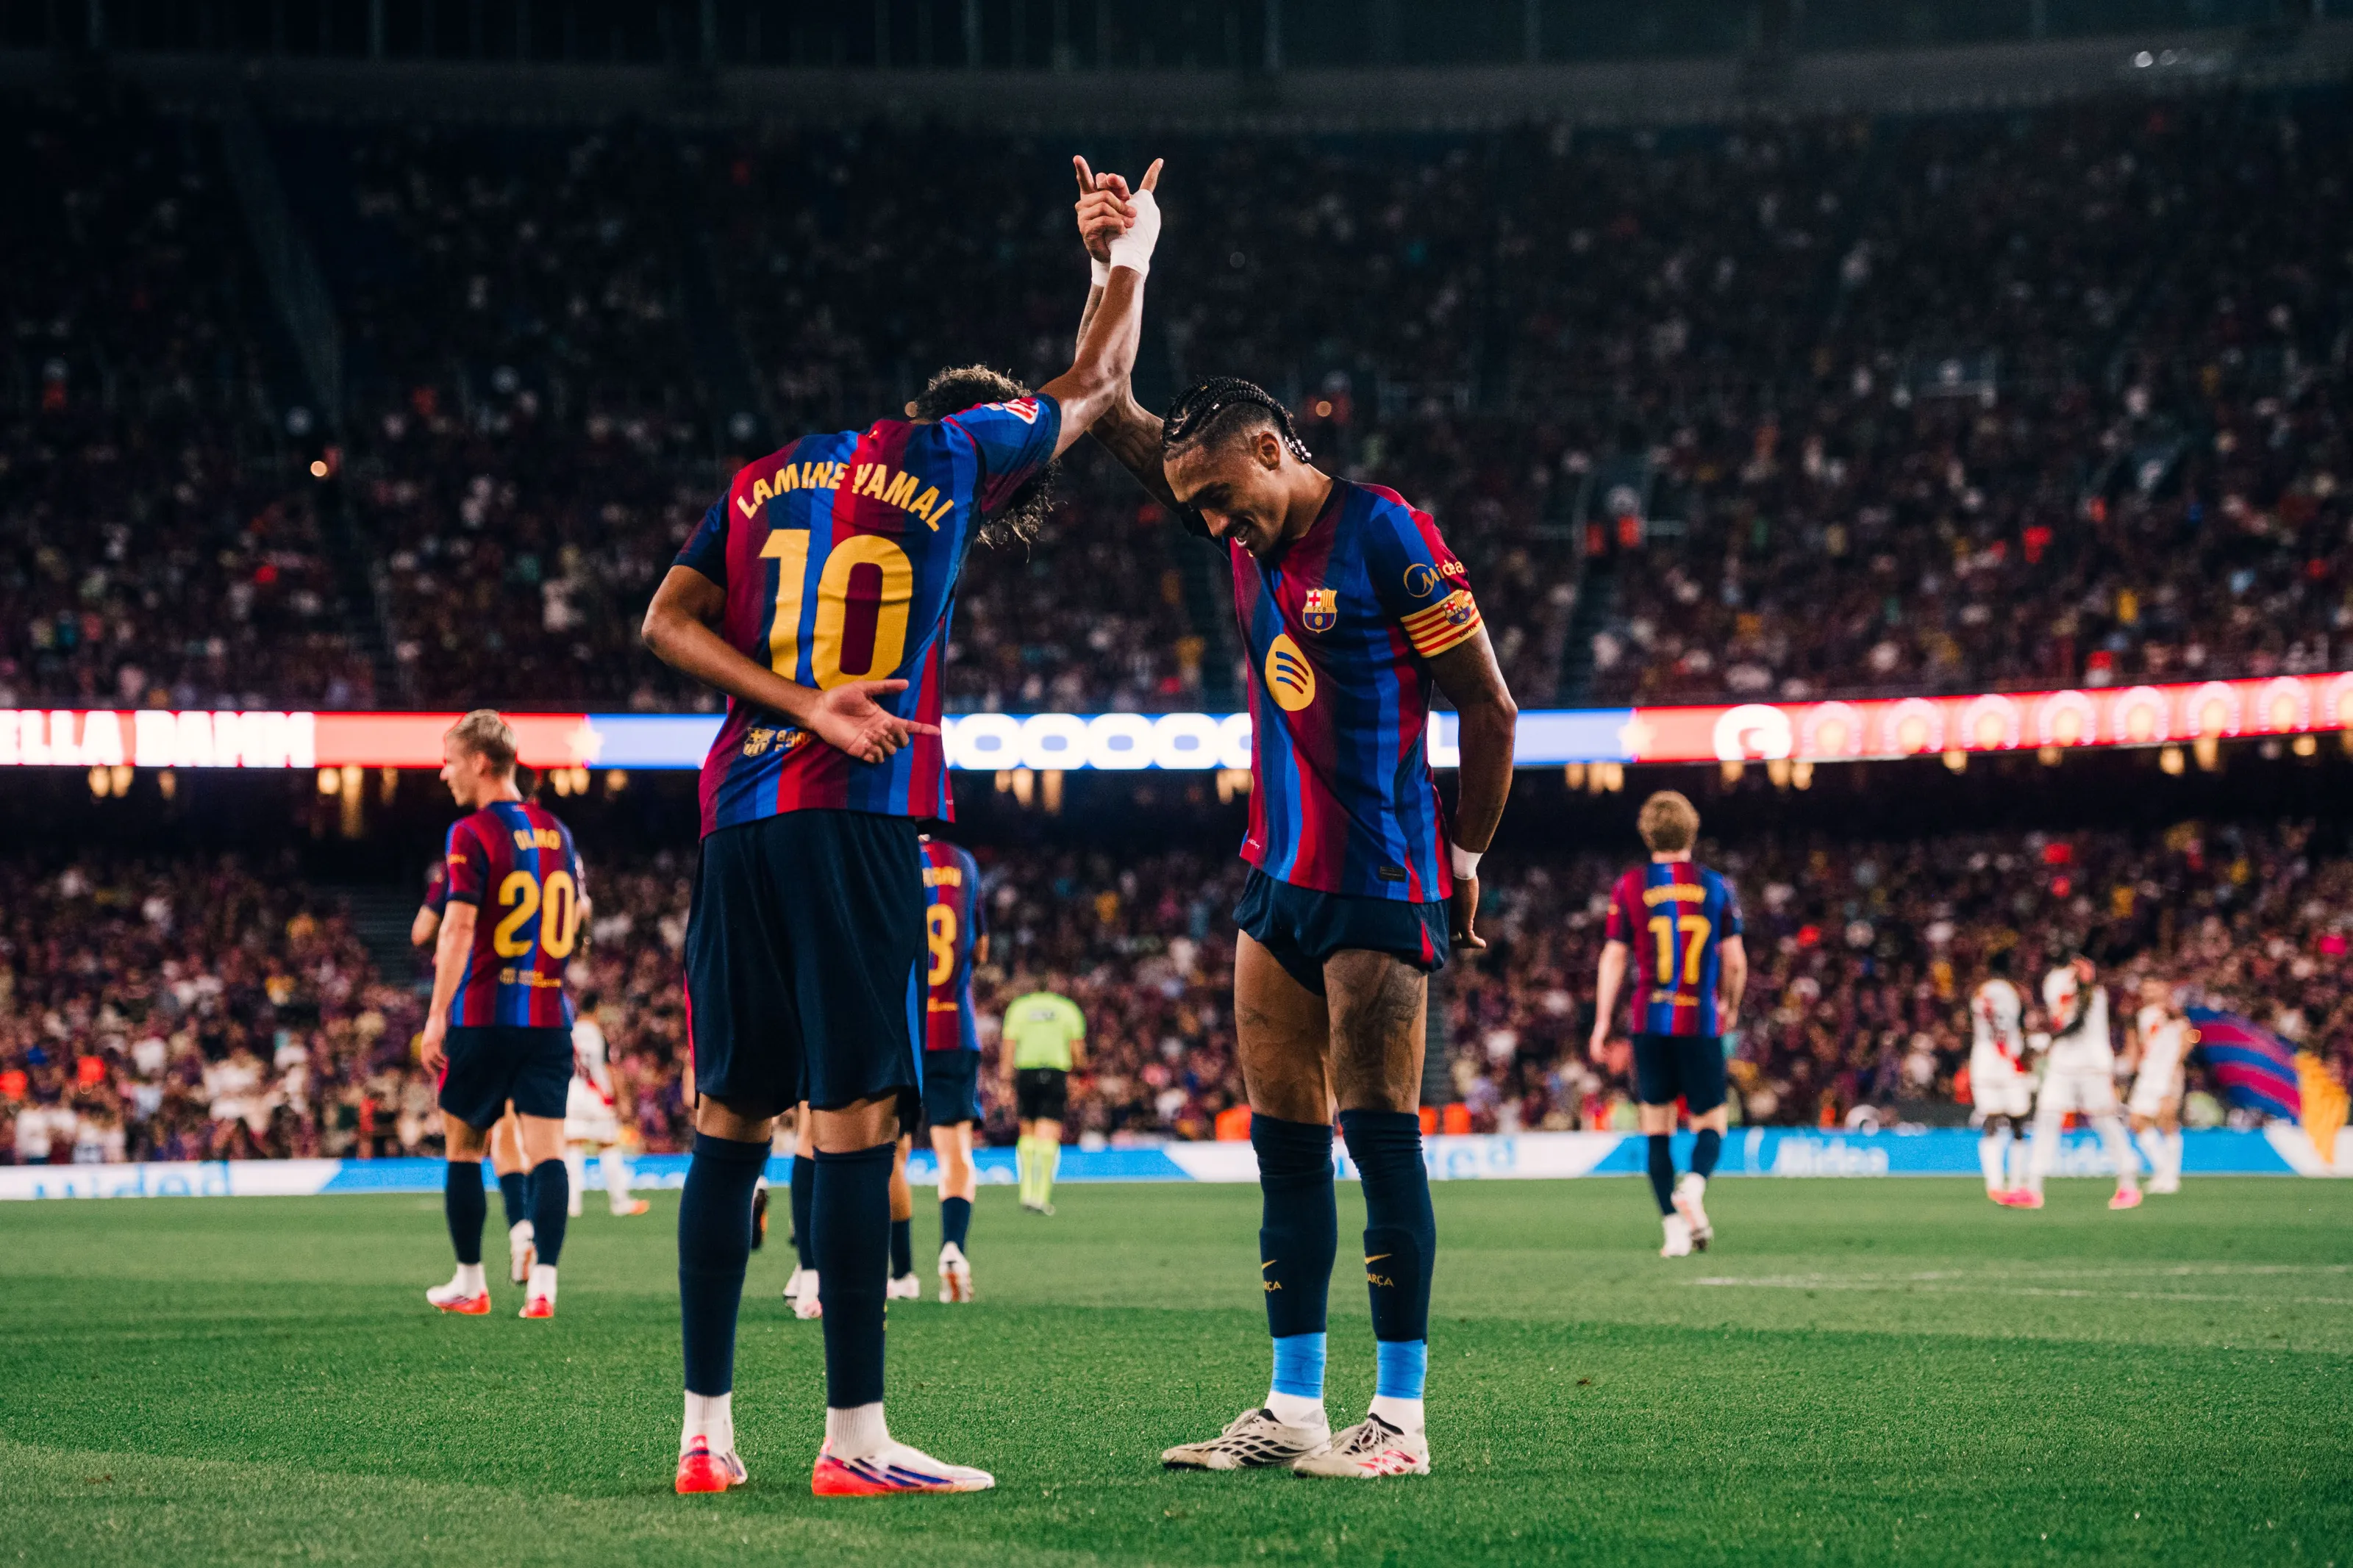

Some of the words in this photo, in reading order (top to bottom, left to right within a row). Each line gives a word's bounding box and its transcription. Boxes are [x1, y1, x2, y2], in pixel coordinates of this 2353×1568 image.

[737, 461, 849, 519] LAMINE
[851, 463, 954, 532] YAMAL
[758, 529, 913, 692] 10
[493, 870, 575, 959] 20
[926, 903, 957, 987] 8
[1646, 914, 1713, 986] 17
[1263, 1281, 1282, 1293] RÇA
[1367, 1272, 1395, 1288] ARÇA
